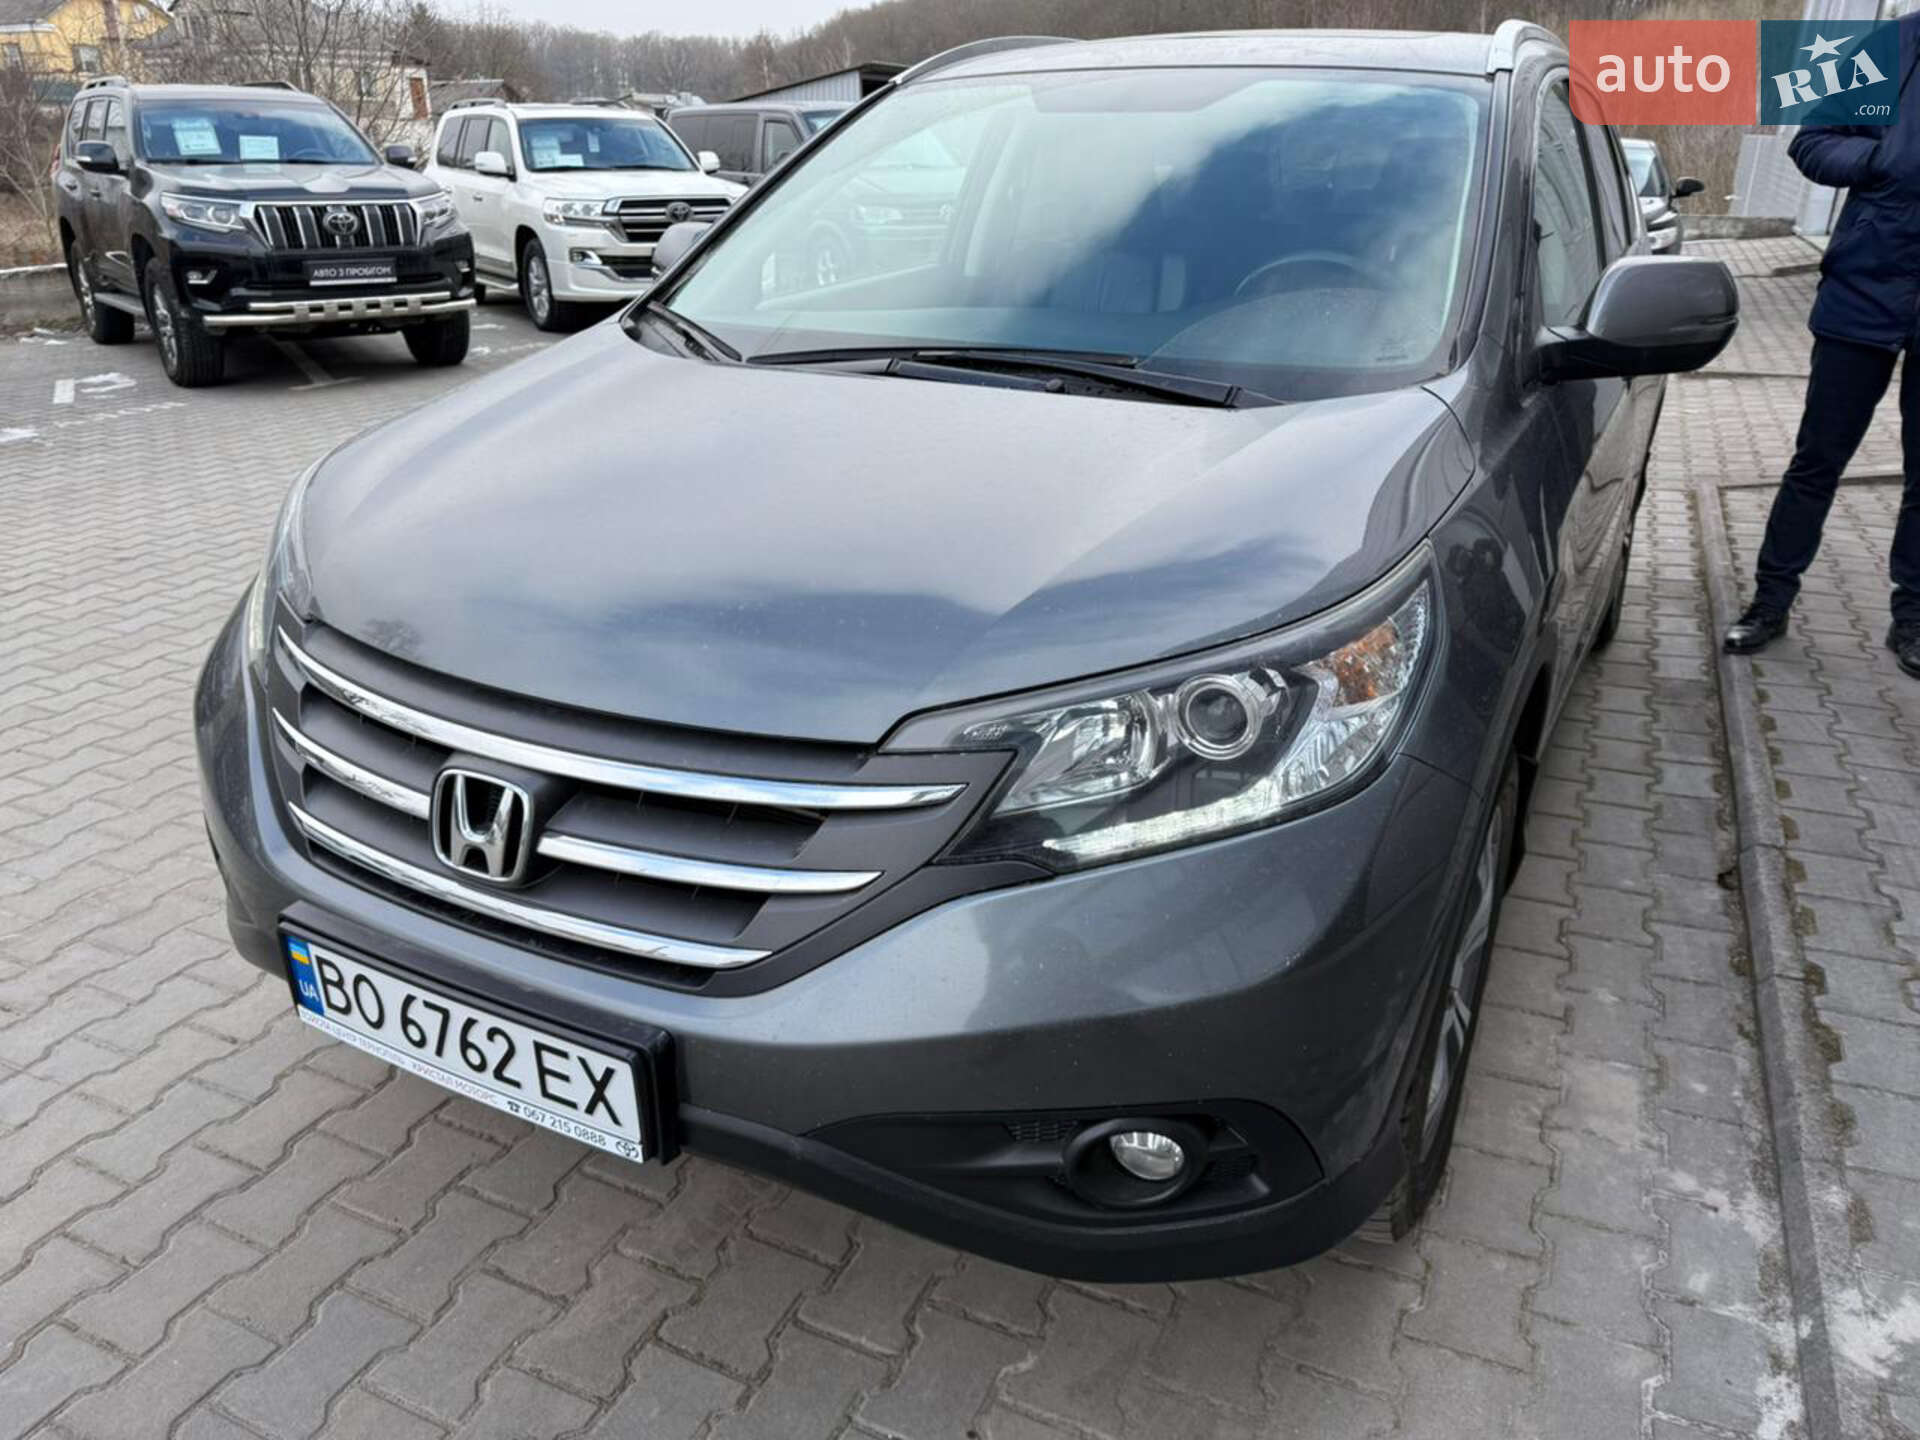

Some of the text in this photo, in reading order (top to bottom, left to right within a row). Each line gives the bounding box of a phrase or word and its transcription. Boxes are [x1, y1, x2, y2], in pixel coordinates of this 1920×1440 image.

[313, 268, 337, 278] АВТО
[299, 979, 320, 1002] UA
[315, 955, 624, 1128] BO 6762 EX
[550, 1115, 572, 1133] 215
